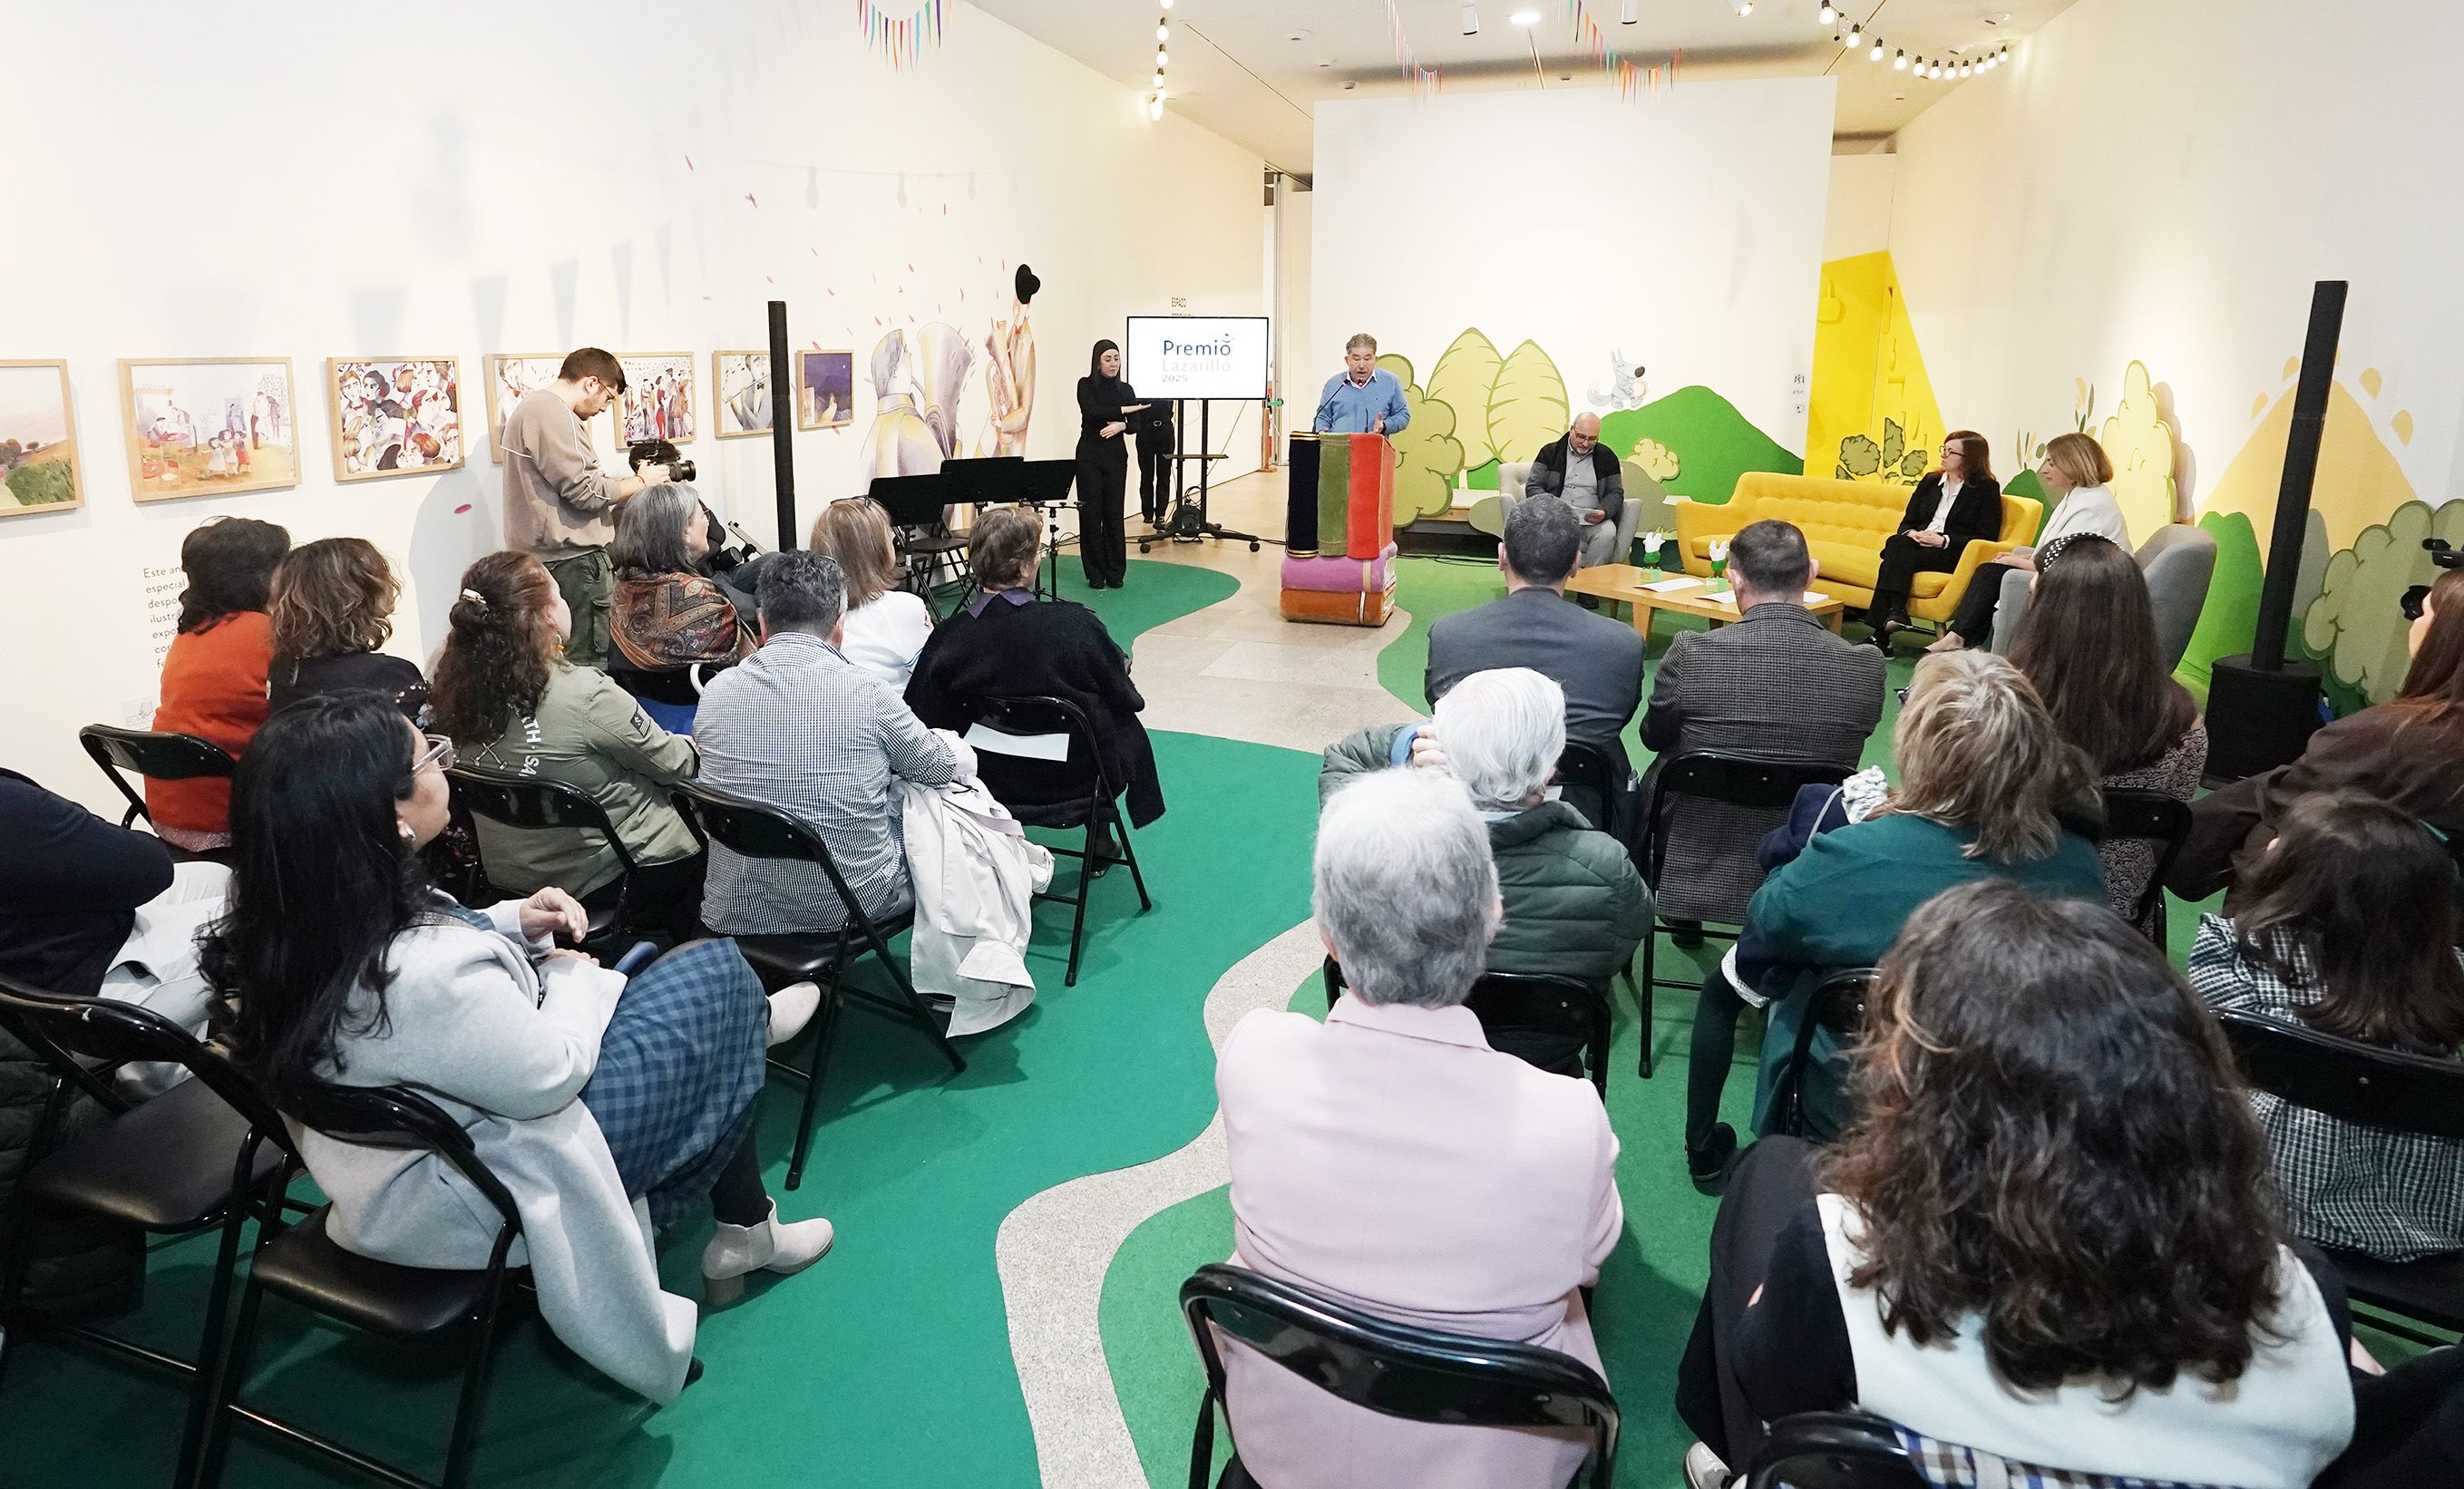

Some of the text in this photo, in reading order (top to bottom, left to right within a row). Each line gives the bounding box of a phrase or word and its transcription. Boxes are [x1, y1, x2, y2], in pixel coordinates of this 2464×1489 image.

[1164, 339, 1231, 356] Premio
[1162, 358, 1232, 372] Lazarillo
[1162, 375, 1188, 383] 2025
[143, 568, 167, 579] Este
[145, 578, 186, 595] especial
